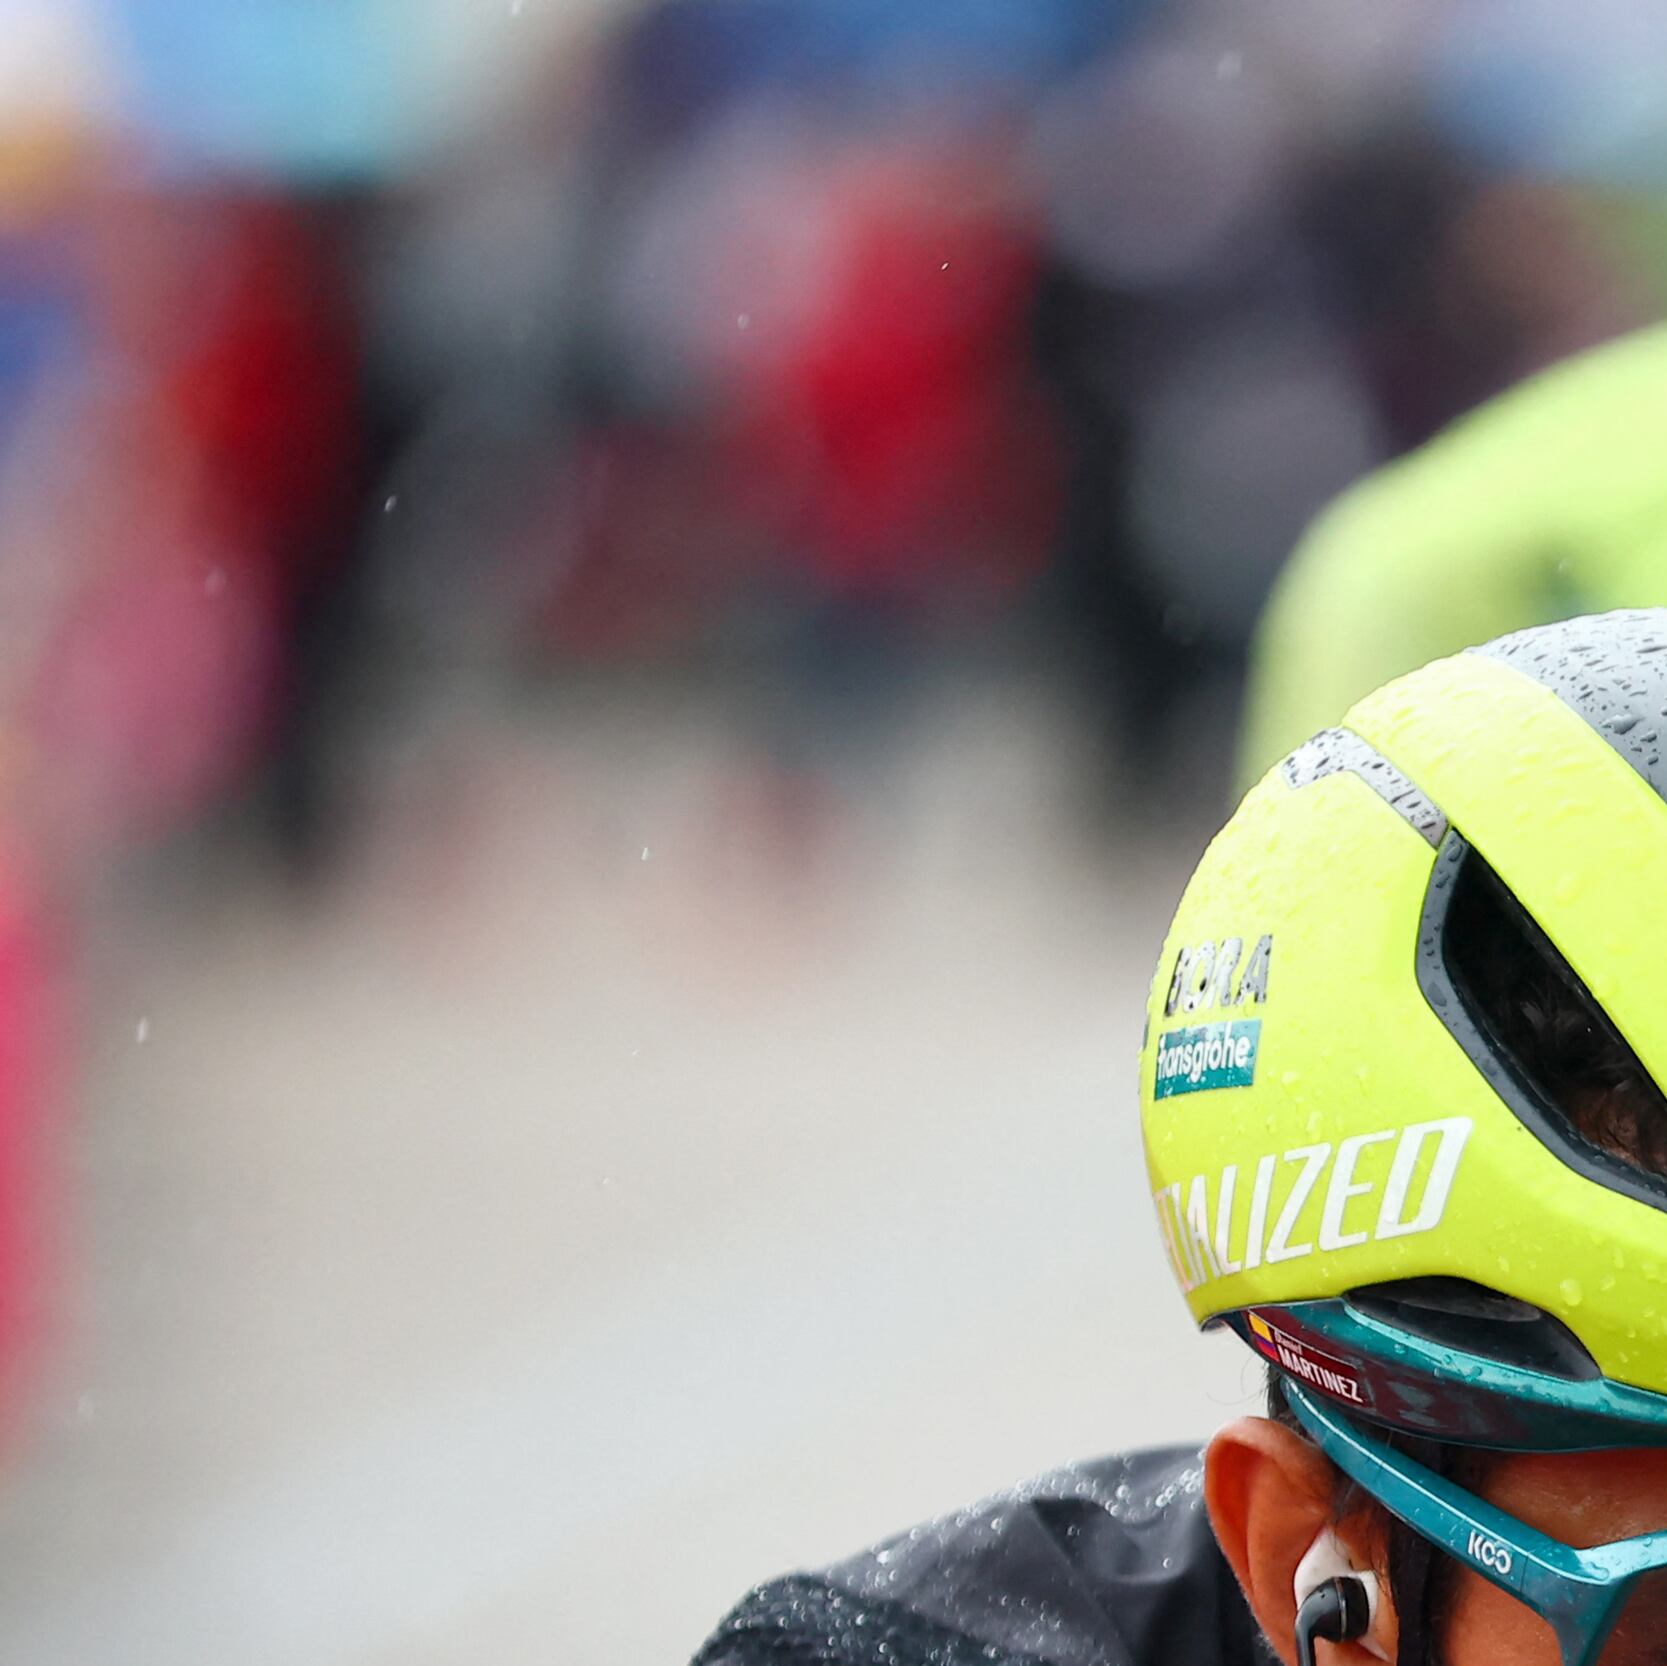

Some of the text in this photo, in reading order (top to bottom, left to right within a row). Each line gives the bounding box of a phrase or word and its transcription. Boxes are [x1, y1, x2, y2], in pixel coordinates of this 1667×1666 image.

[1164, 934, 1273, 1018] BORA
[1157, 1021, 1251, 1083] hansgrohe
[1277, 1344, 1364, 1403] MARTINEZ
